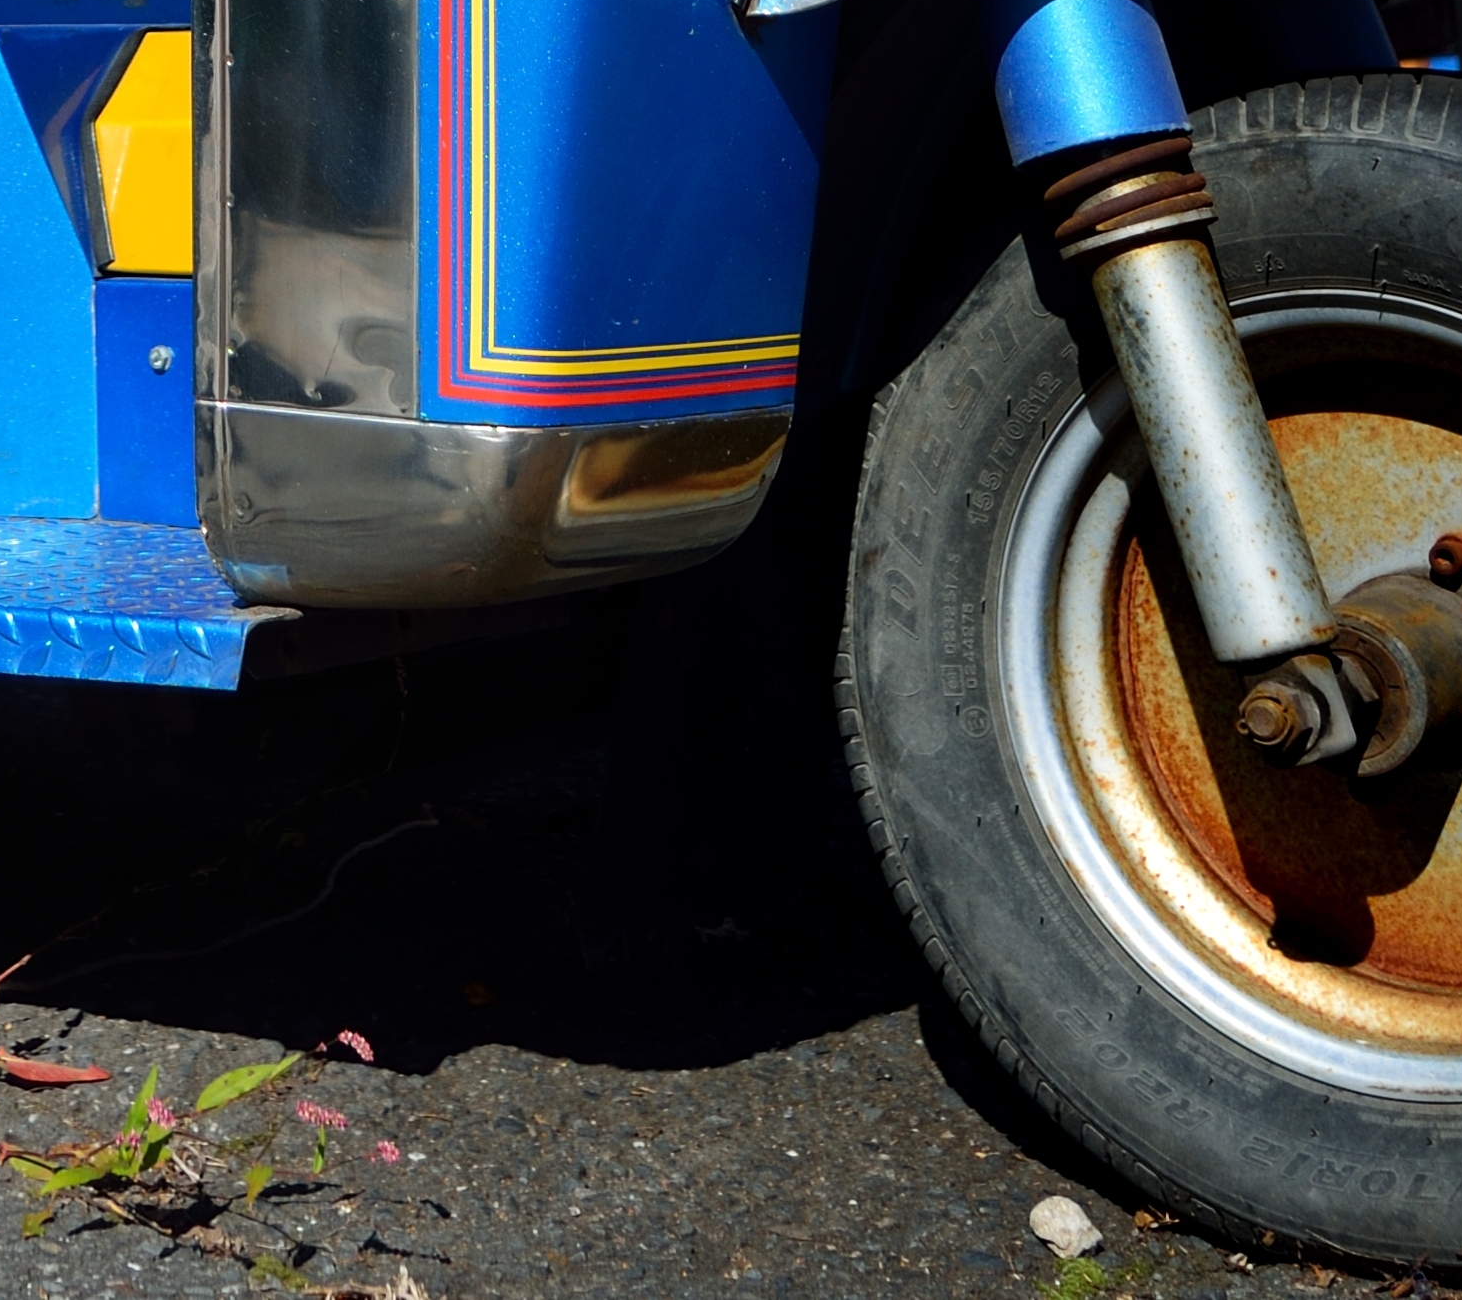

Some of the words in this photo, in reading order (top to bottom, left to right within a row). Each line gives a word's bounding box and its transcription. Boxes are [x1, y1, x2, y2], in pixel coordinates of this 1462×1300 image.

[1402, 268, 1453, 294] RADIAL
[881, 276, 1053, 642] DEEST
[965, 364, 1064, 530] 155/70R12
[1046, 993, 1216, 1141] R202
